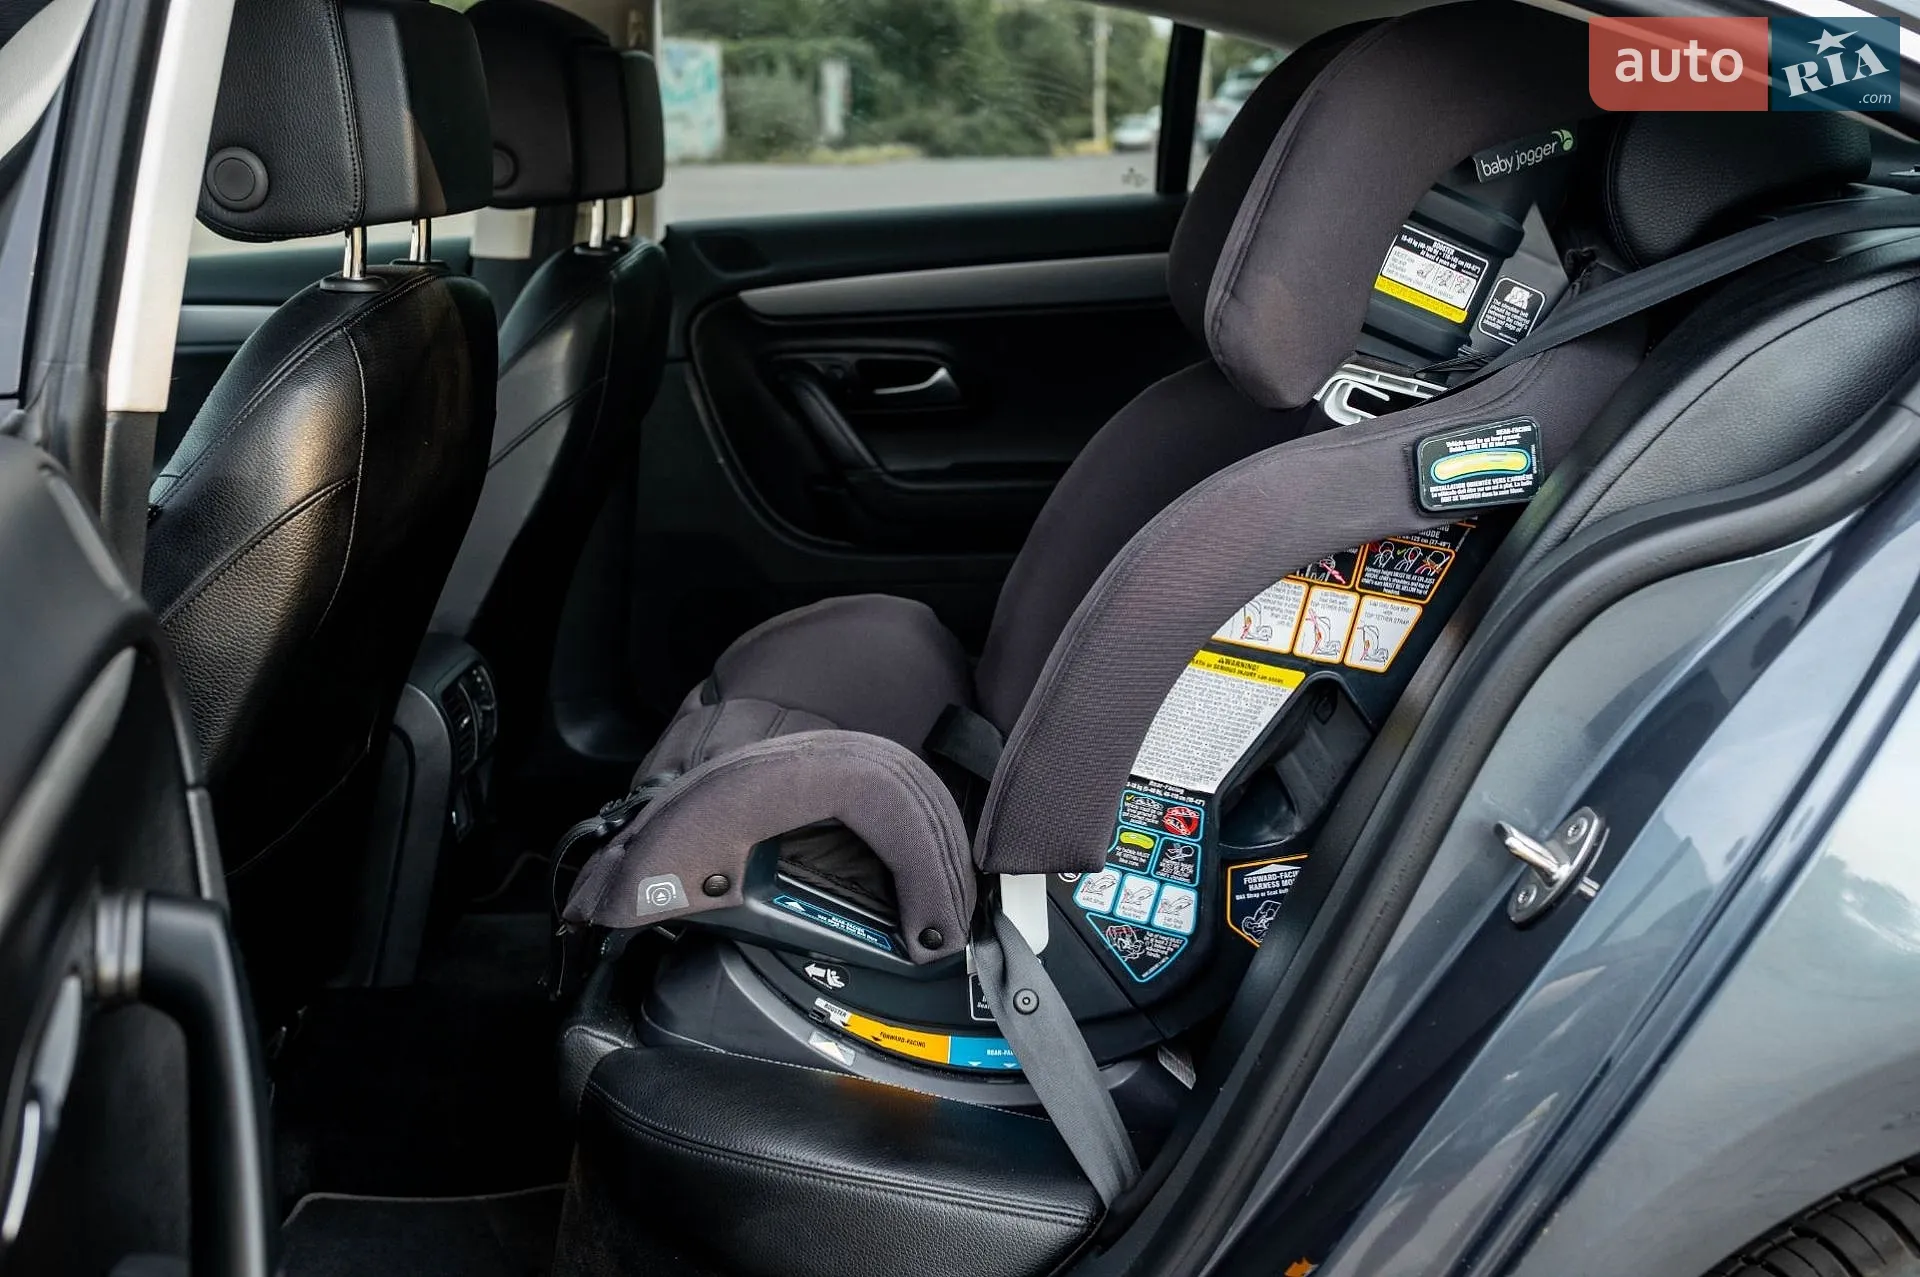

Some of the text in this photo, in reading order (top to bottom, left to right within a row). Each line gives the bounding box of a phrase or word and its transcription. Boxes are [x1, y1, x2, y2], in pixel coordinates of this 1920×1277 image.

[1480, 141, 1558, 176] baby jogger
[1433, 242, 1454, 255] BOOSTER
[1419, 530, 1440, 538] ODE
[1249, 880, 1280, 891] HARNESS
[824, 1003, 847, 1018] BOOSTER
[880, 1031, 926, 1048] FORWARD-FACING
